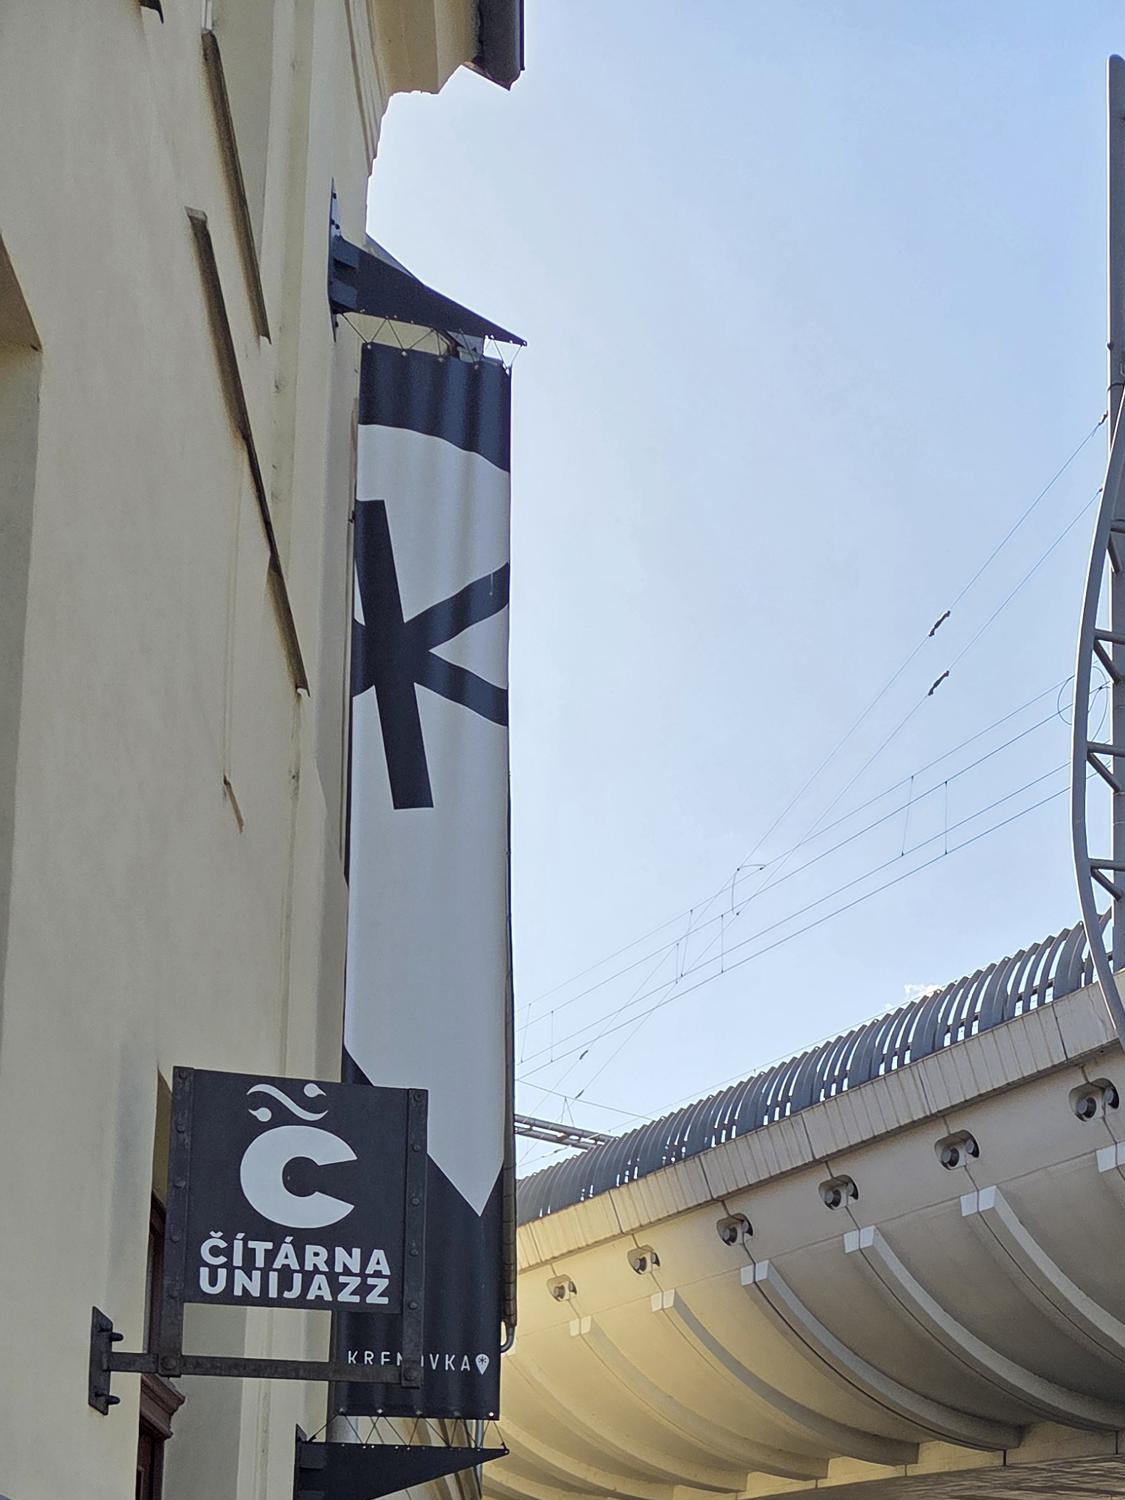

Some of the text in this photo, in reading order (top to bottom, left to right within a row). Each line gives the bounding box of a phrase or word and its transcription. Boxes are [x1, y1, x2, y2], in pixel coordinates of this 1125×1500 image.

[200, 1230, 392, 1277] ČÍTÁRNA
[199, 1266, 390, 1305] UNIJAZZ
[347, 1350, 471, 1372] KREVKA
